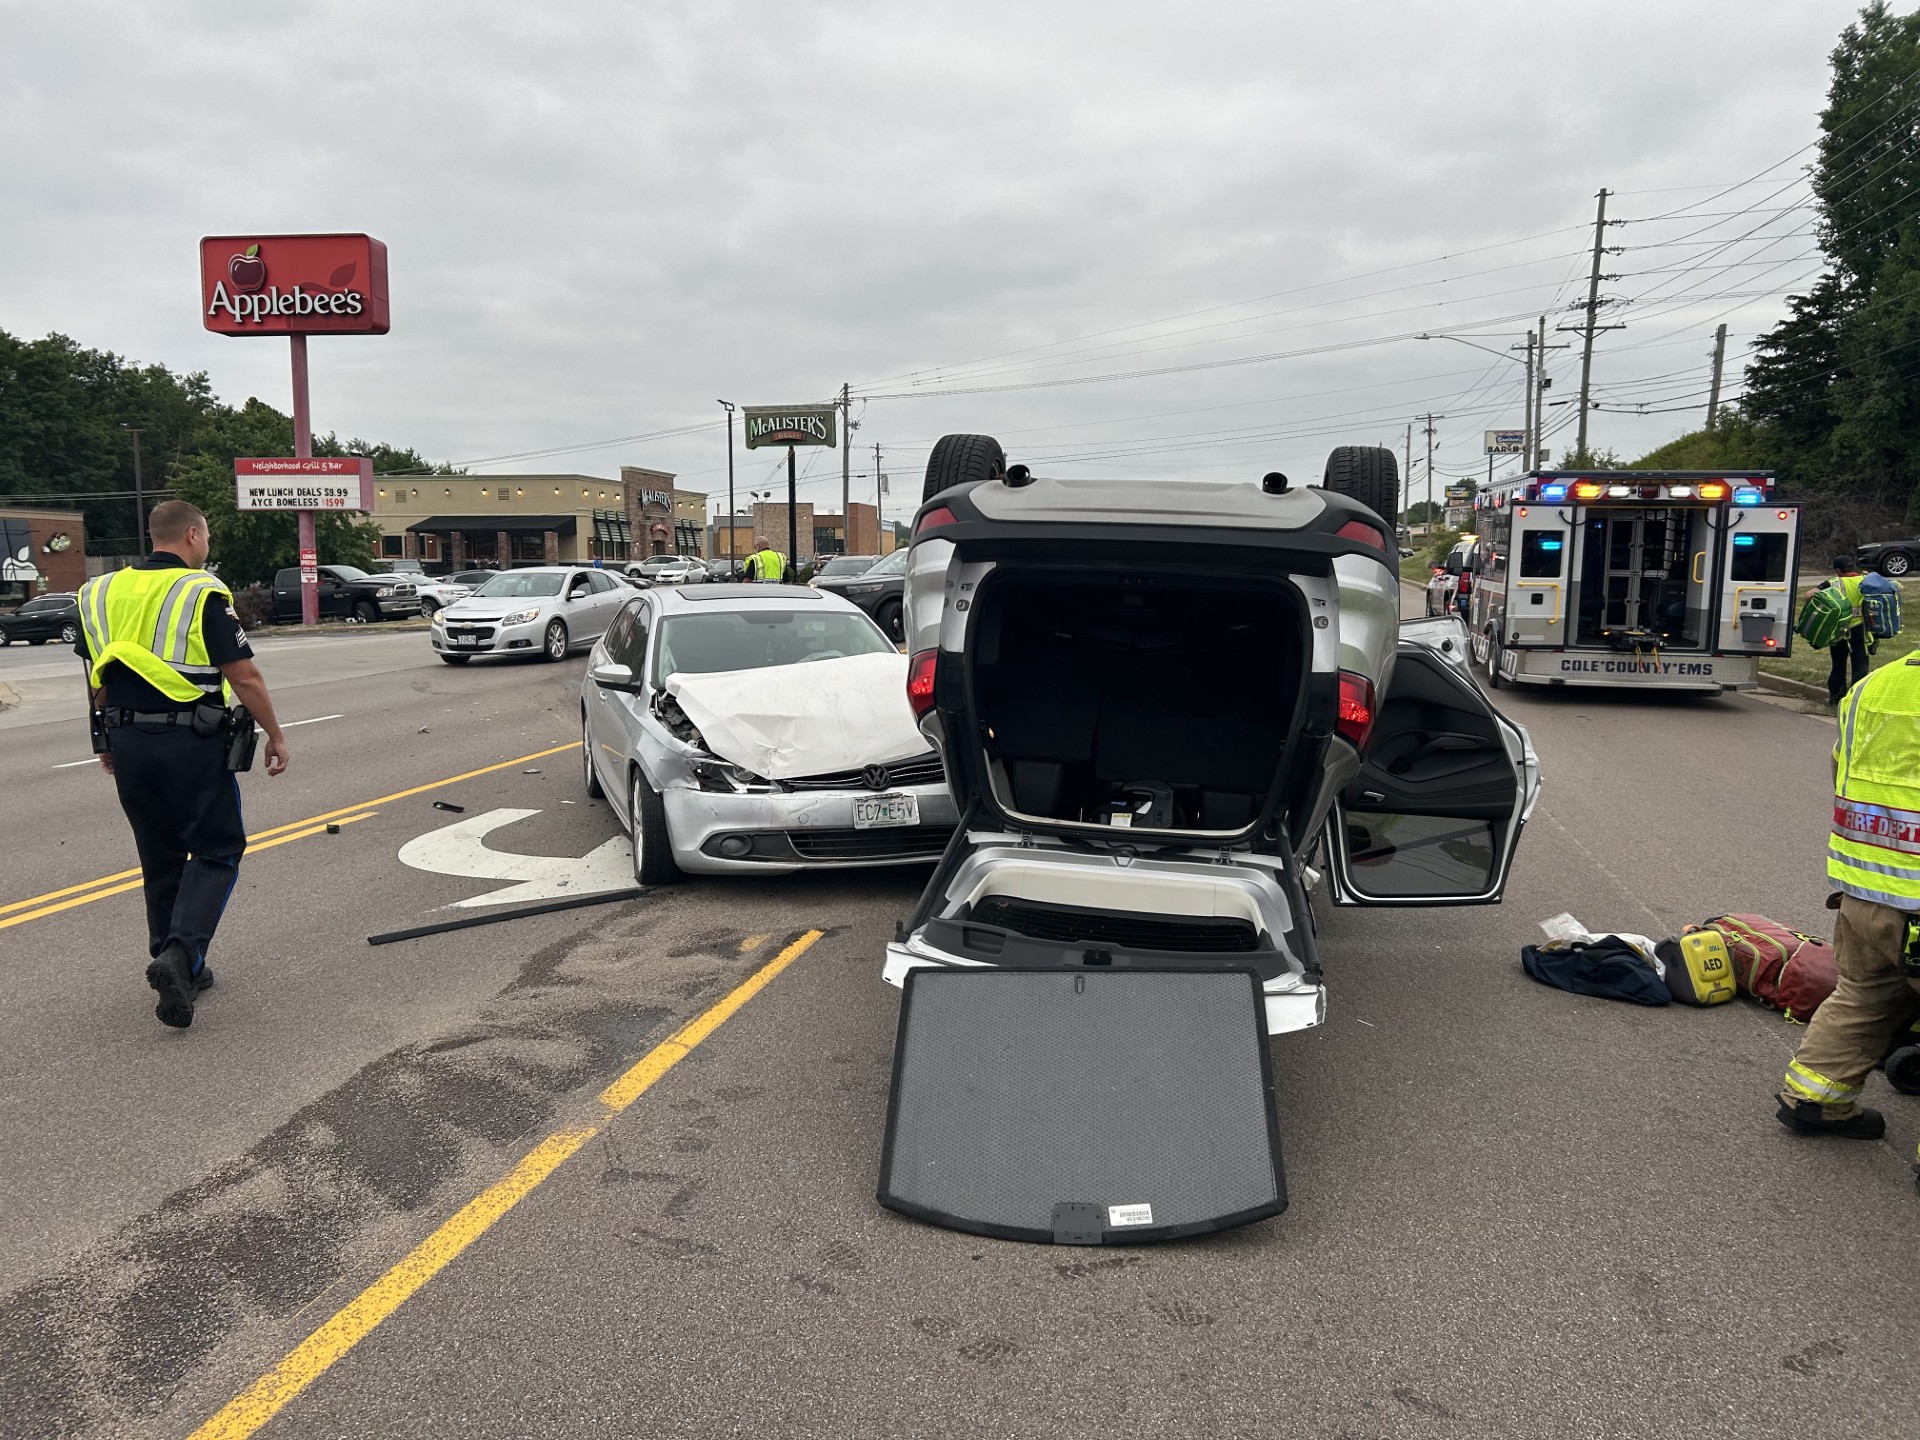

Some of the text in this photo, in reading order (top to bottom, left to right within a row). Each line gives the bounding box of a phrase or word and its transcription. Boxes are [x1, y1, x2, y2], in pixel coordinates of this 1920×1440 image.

[208, 280, 362, 322] Applebee's
[253, 461, 300, 471] Neighborhood
[249, 488, 348, 496] NEW LUNCH DEALS $9.99
[252, 498, 273, 506] AYCE
[277, 498, 319, 506] BONELESS
[1561, 659, 1599, 672] COLE
[1678, 663, 1713, 675] EMS
[857, 804, 881, 821] EC7
[1845, 810, 1919, 842] FIRE DEPT
[1703, 957, 1723, 972] AED
